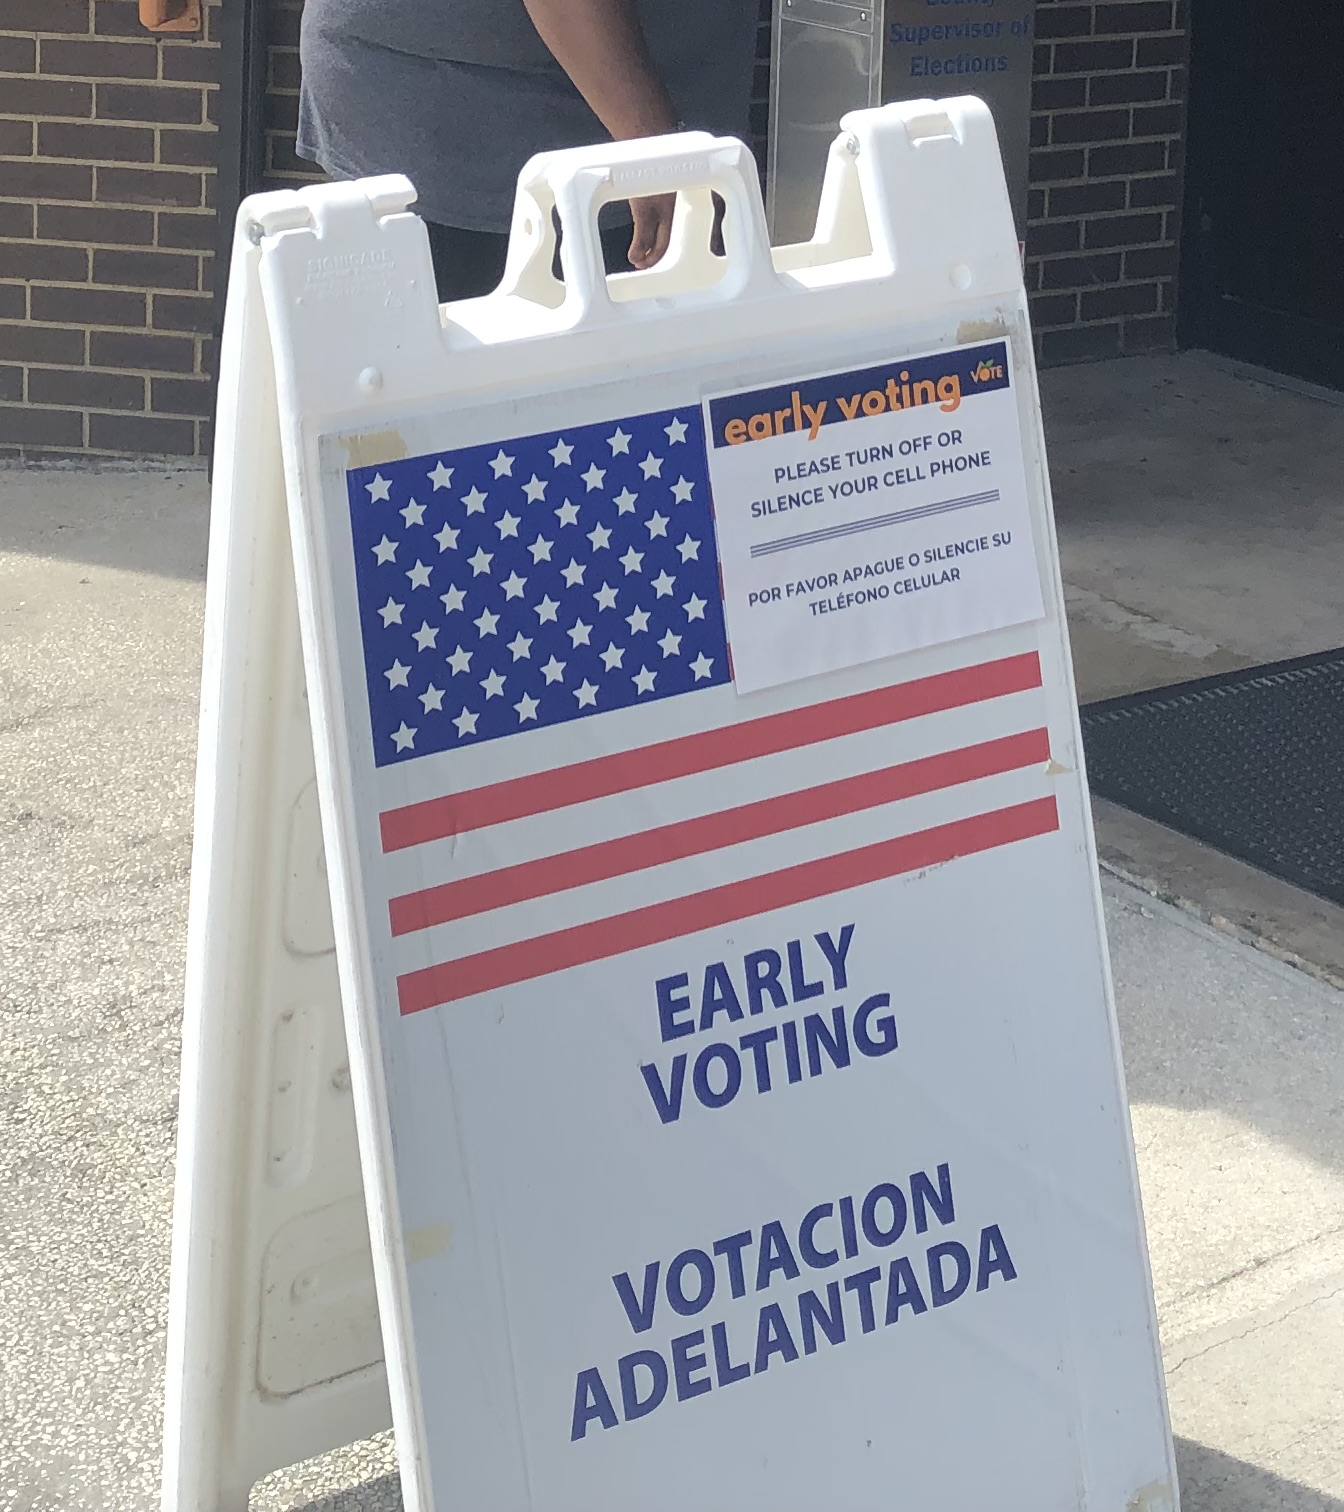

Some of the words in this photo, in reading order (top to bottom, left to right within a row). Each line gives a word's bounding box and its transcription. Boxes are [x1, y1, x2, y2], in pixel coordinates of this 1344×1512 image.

[890, 20, 1003, 47] Supervisor
[1010, 16, 1031, 37] of
[910, 54, 1008, 77] Elections
[724, 391, 828, 446] early
[836, 370, 962, 422] voting
[970, 359, 1004, 385] VOTE
[750, 486, 824, 518] SILENCE
[828, 475, 879, 501] YOUR
[882, 464, 926, 488] CELL
[930, 450, 992, 479] PHONE
[774, 454, 842, 484] PLEASE
[845, 444, 894, 469] TURN
[899, 435, 933, 456] OFF
[937, 428, 963, 447] OR
[748, 587, 782, 607] POR
[785, 573, 838, 600] FAVOR
[842, 556, 905, 585] APAGUE
[908, 552, 920, 567] O
[923, 535, 990, 564] SILENCIE
[992, 531, 1012, 548] SU
[809, 585, 890, 617] TELÉFONO
[893, 567, 961, 595] CELULAR
[655, 923, 856, 1043] EARLY
[640, 993, 899, 1125] VOTING
[612, 1162, 956, 1335] VOTACION
[570, 1223, 1018, 1443] ADELANTADA
